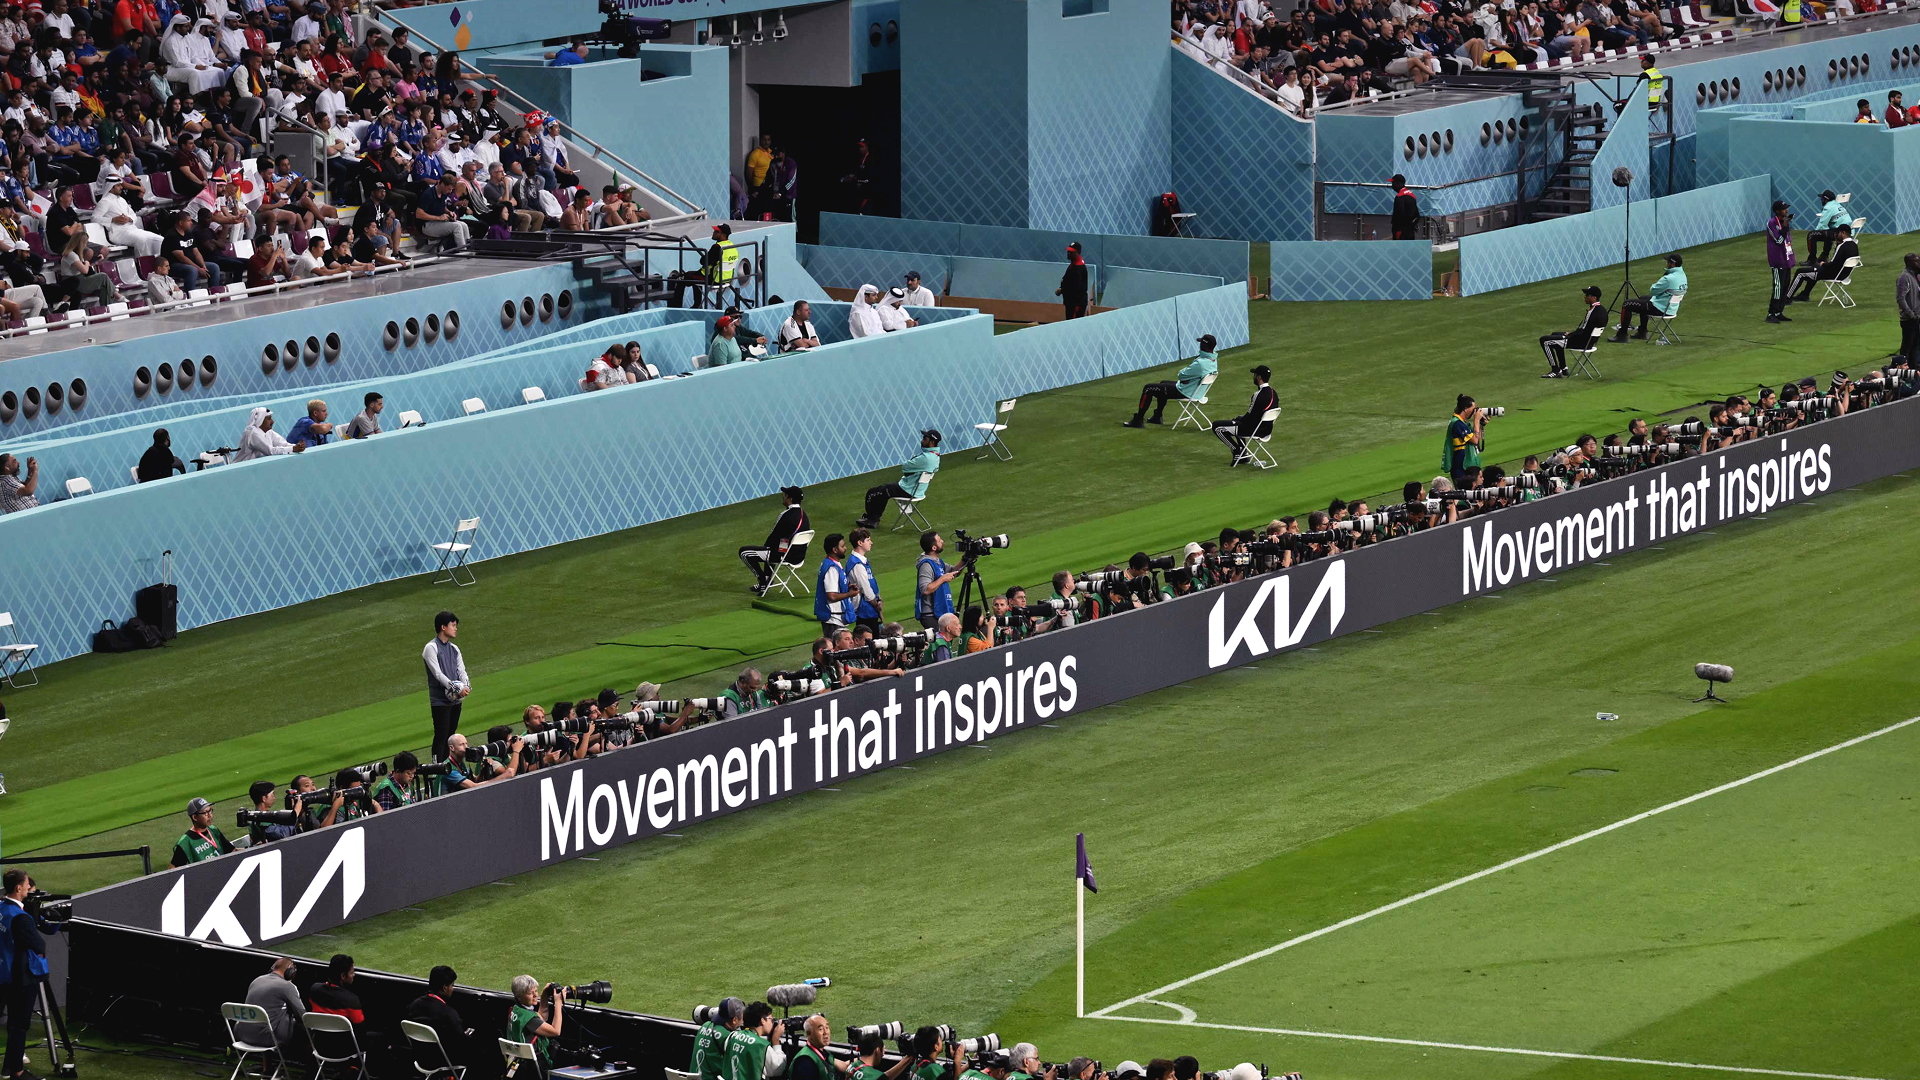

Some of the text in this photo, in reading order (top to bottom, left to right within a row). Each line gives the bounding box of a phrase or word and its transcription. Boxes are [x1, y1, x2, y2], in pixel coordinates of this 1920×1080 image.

[1463, 440, 1832, 595] Movement that inspires
[541, 651, 1078, 860] Movement that inspires
[231, 1006, 257, 1020] LED
